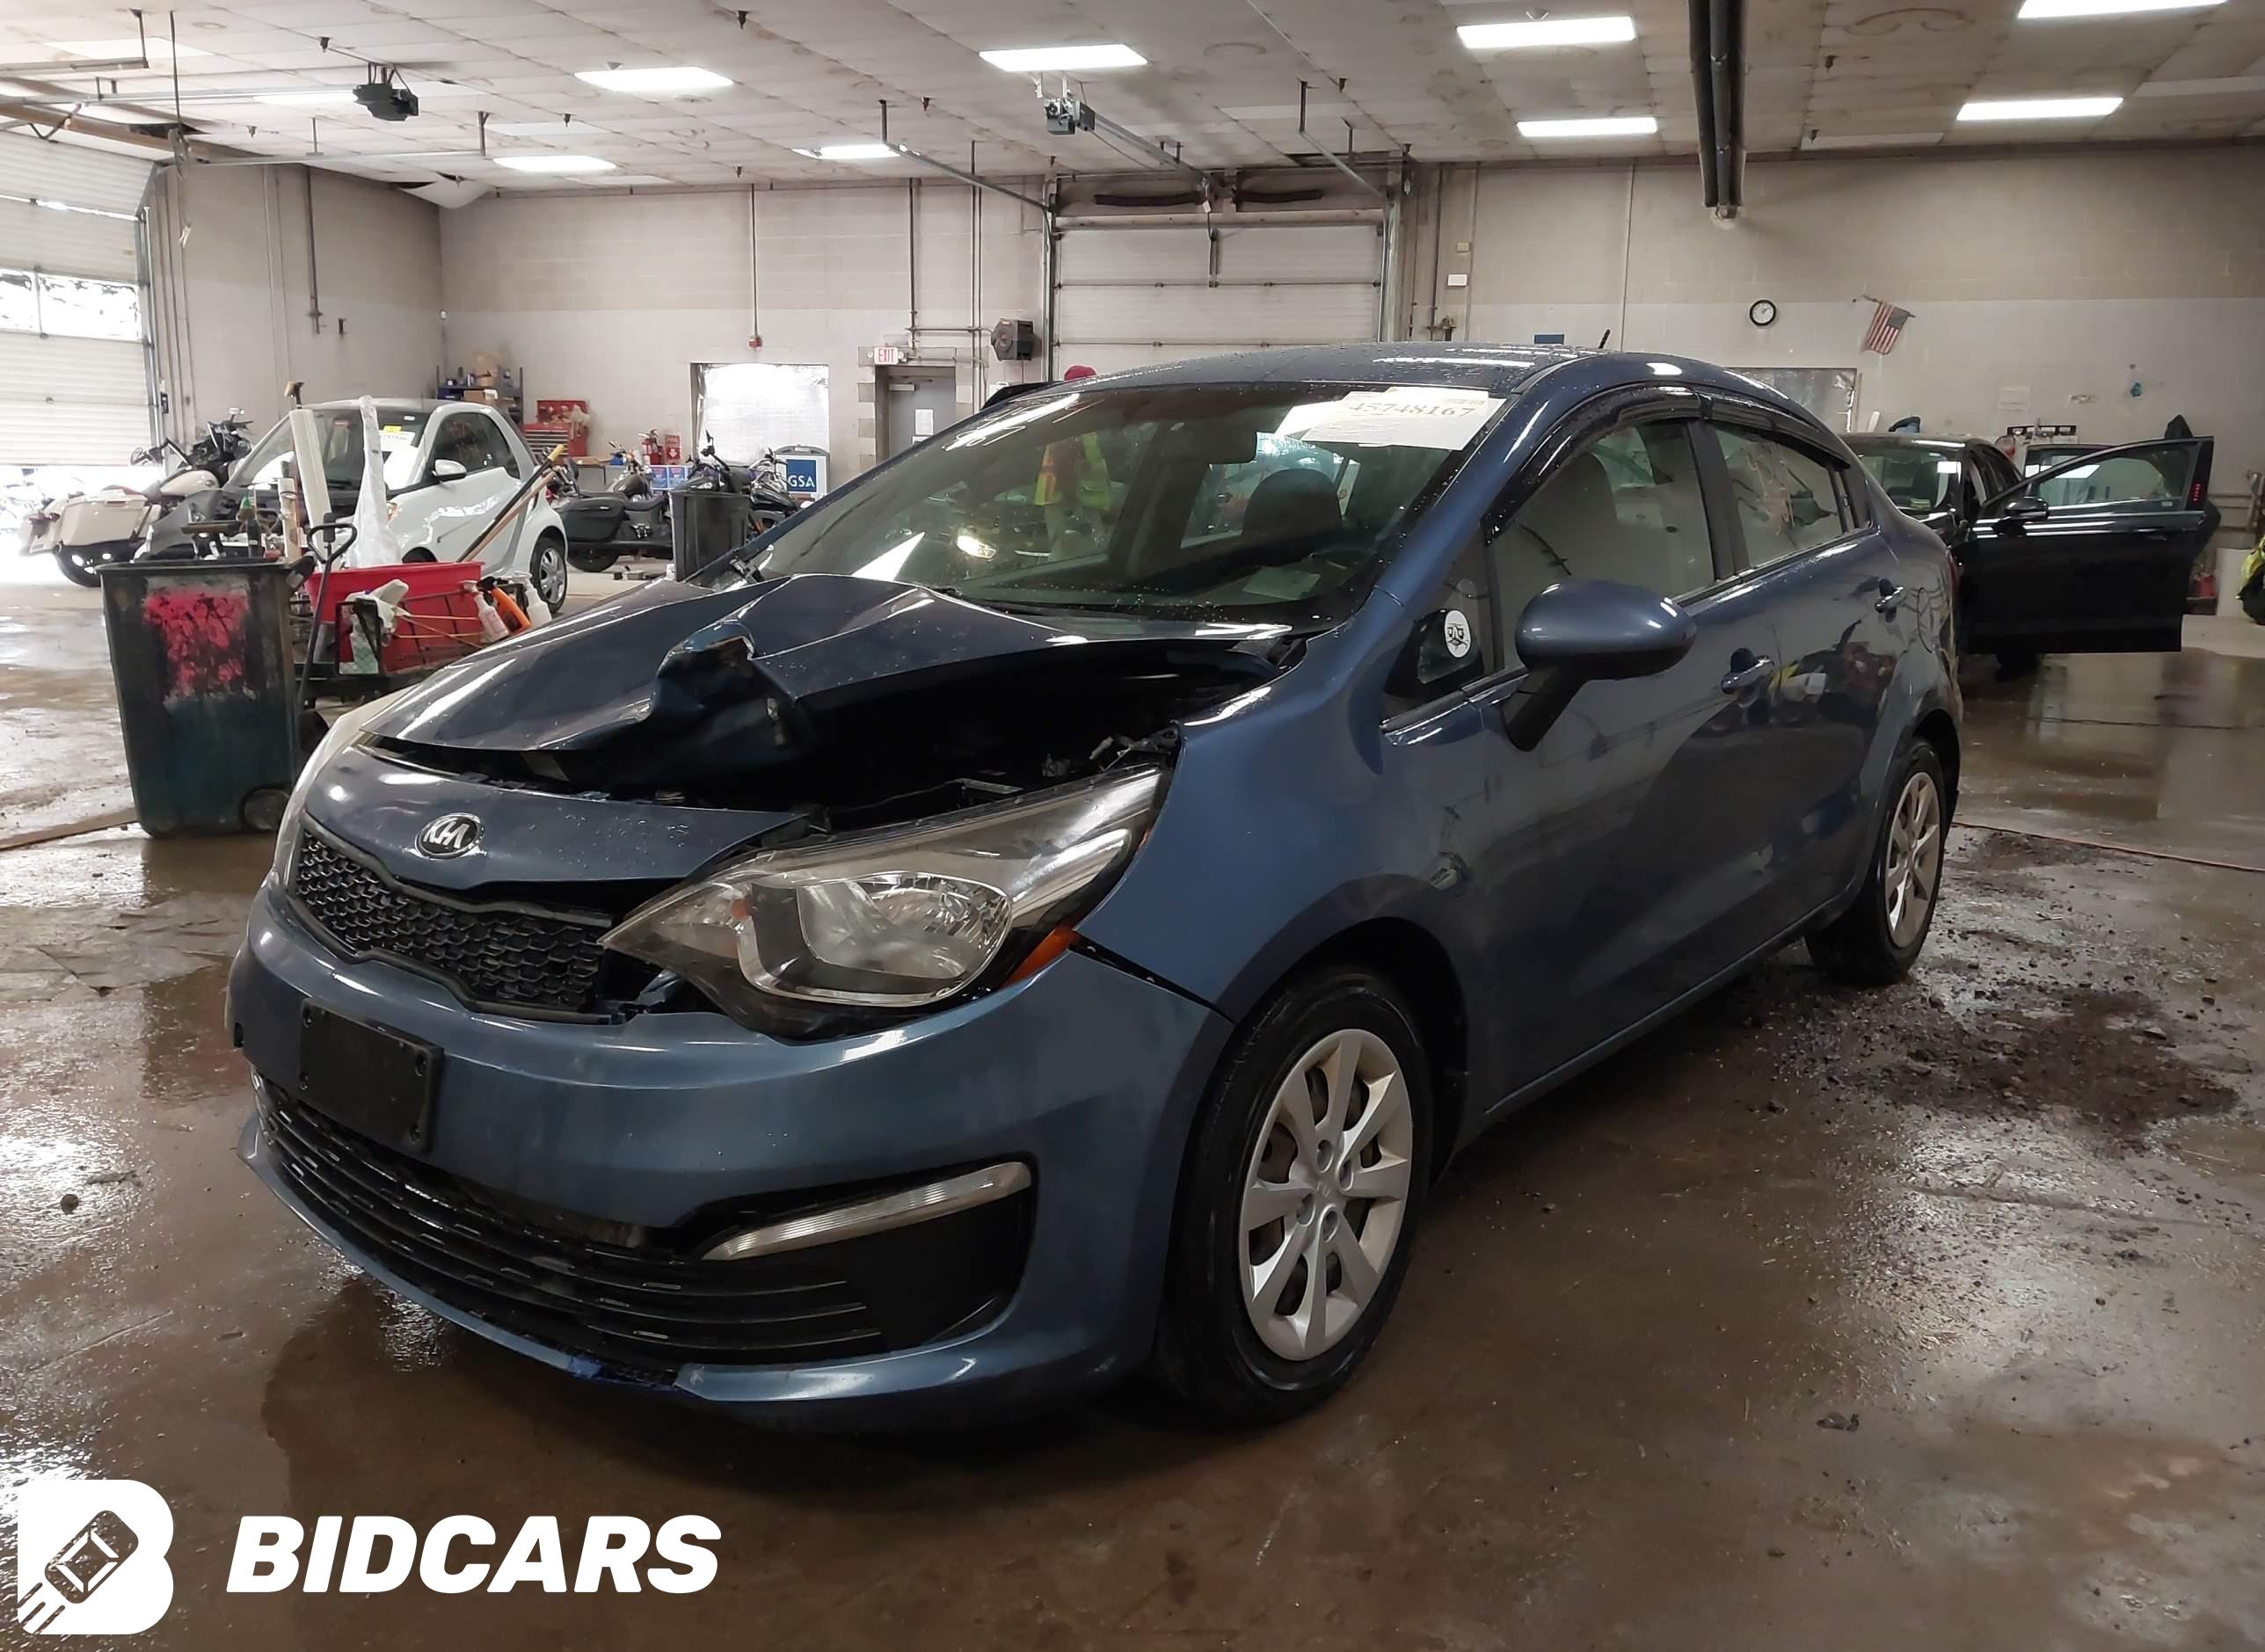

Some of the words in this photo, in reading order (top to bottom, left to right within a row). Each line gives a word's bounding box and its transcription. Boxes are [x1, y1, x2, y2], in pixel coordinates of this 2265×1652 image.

[878, 348, 895, 363] EXIT
[788, 475, 815, 488] GSA
[422, 817, 470, 849] KIA
